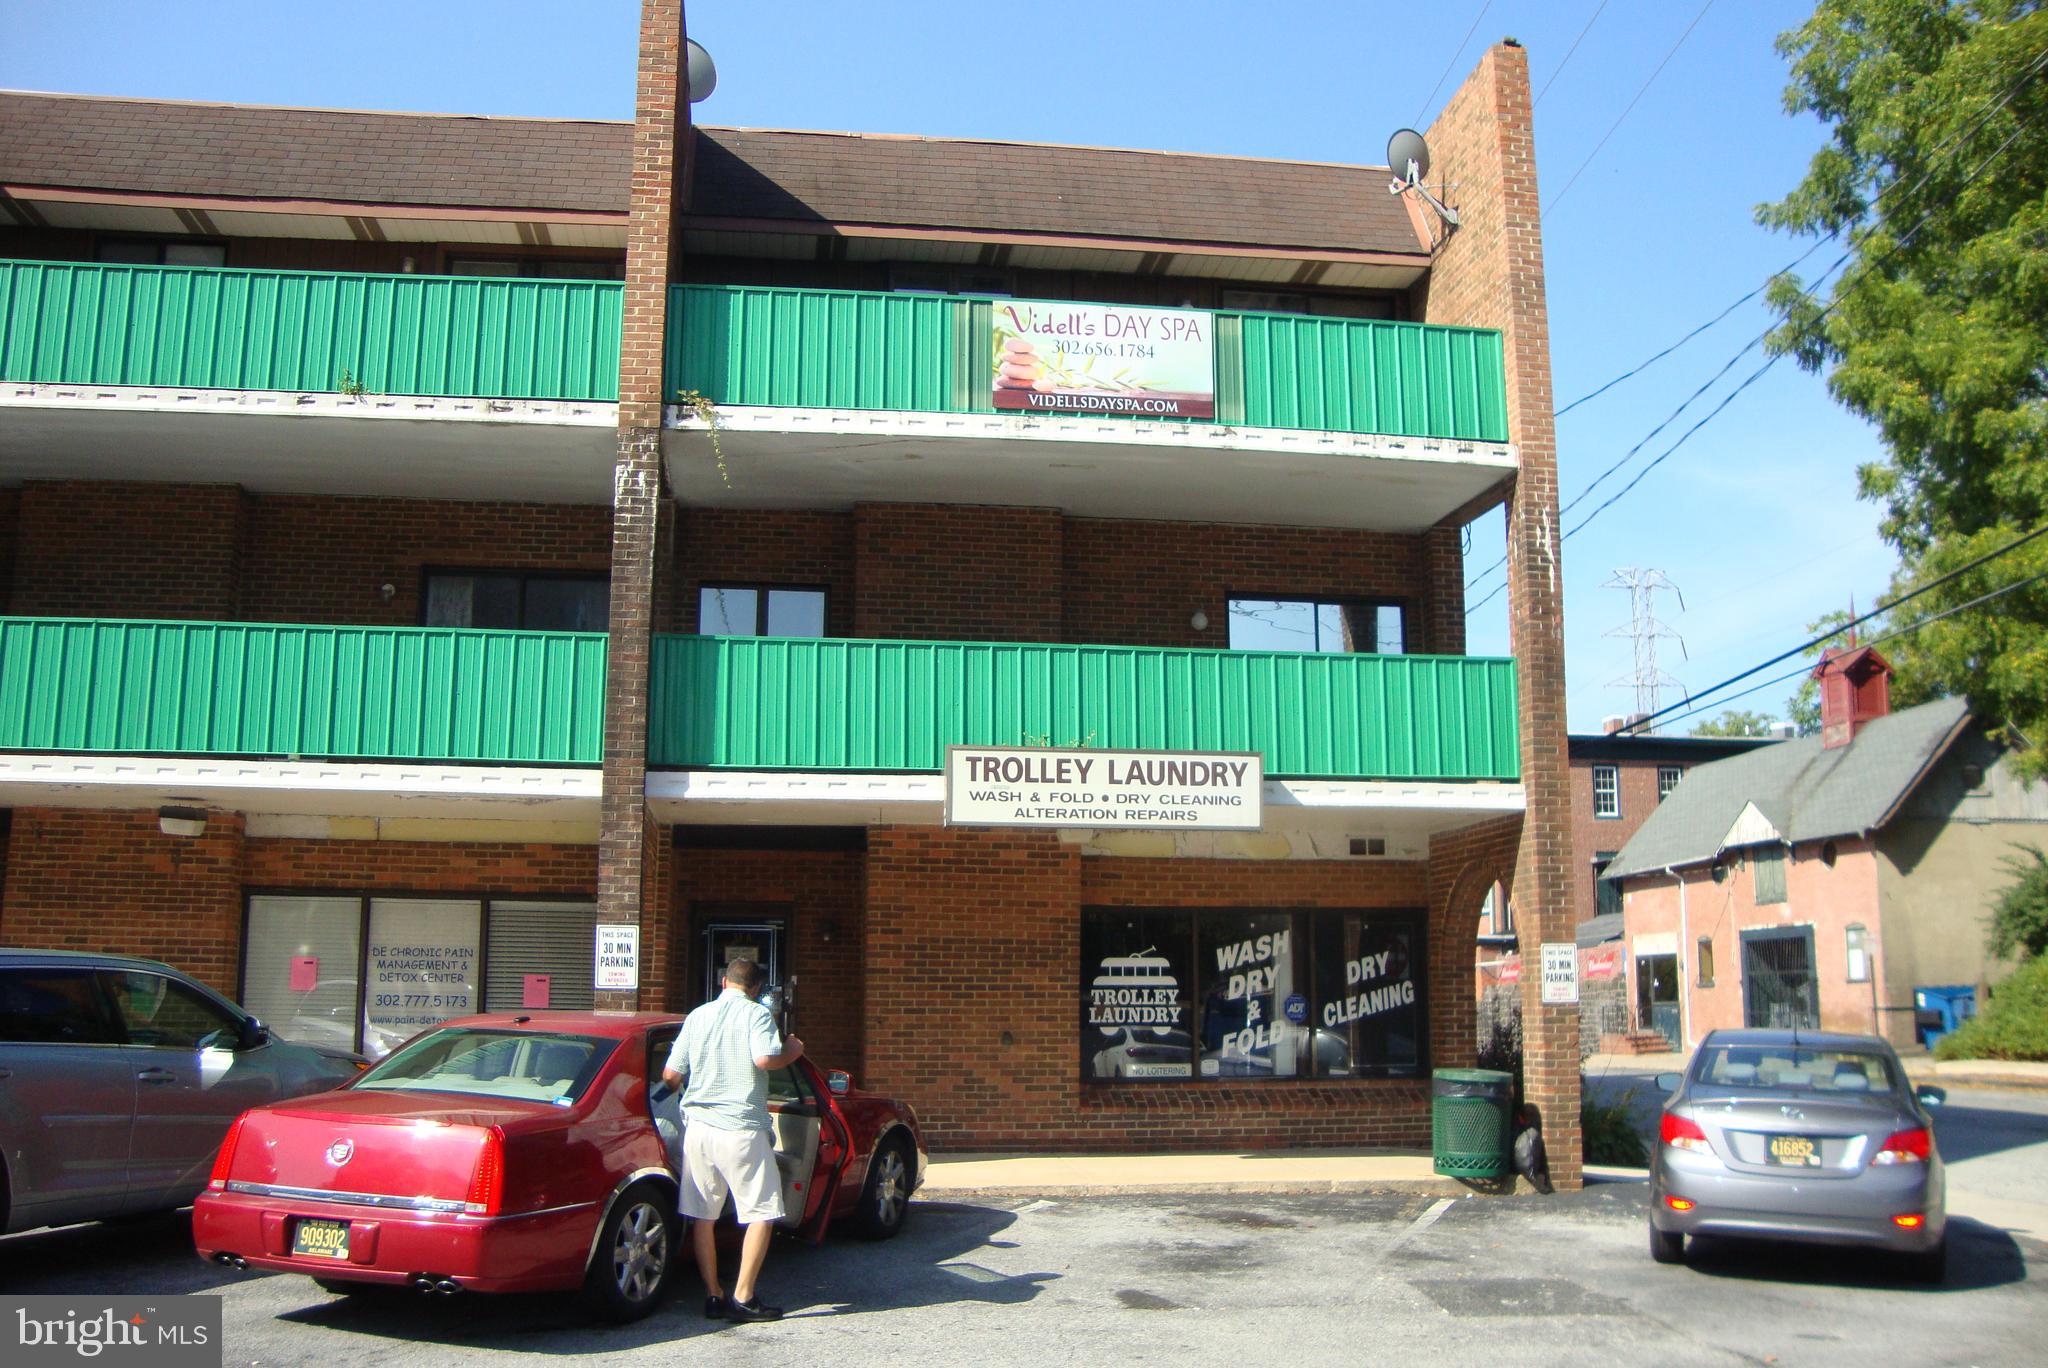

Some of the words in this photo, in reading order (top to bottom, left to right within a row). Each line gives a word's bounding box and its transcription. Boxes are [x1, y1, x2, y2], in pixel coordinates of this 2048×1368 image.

[1004, 305, 1096, 336] Videll's
[1104, 313, 1152, 339] DAY
[1160, 317, 1202, 342] SPA
[1052, 340, 1155, 359] 302.656.1784
[1028, 394, 1179, 413] VIDELLSDAYSPA.COM
[965, 756, 1094, 784] TROLLEY
[1108, 759, 1249, 787] LAUNDRY
[969, 790, 1022, 802] WASH
[1030, 791, 1041, 803] &
[1050, 792, 1094, 803] FOLD
[1116, 793, 1151, 804] DRY
[1159, 794, 1242, 807] CLEANING
[1014, 807, 1117, 820] ALTERATION
[1125, 809, 1198, 822] REPAIRS
[390, 947, 442, 957] CHRONIC
[445, 947, 474, 957] PAIN
[603, 942, 613, 954] 30
[616, 942, 631, 954] MIN
[1216, 929, 1290, 972] WASH
[376, 960, 459, 970] MANAGEMENT
[461, 961, 468, 970] &
[600, 956, 634, 967] PARKING
[1347, 951, 1390, 985] DRY
[1547, 960, 1557, 970] 30
[1559, 960, 1572, 970] MIN
[379, 972, 418, 982] DETOX
[421, 972, 465, 983] CENTER
[1228, 964, 1281, 1000] DRY
[1545, 973, 1575, 984] PARKING
[375, 994, 467, 1007] 302.777.5173
[1090, 988, 1180, 1006] TROLLEY
[1323, 980, 1415, 1027] CLEANING
[1089, 1007, 1182, 1023] LAUNDRY
[1247, 999, 1261, 1021] &
[1222, 1020, 1287, 1058] FOLD
[300, 1226, 346, 1248] 909302
